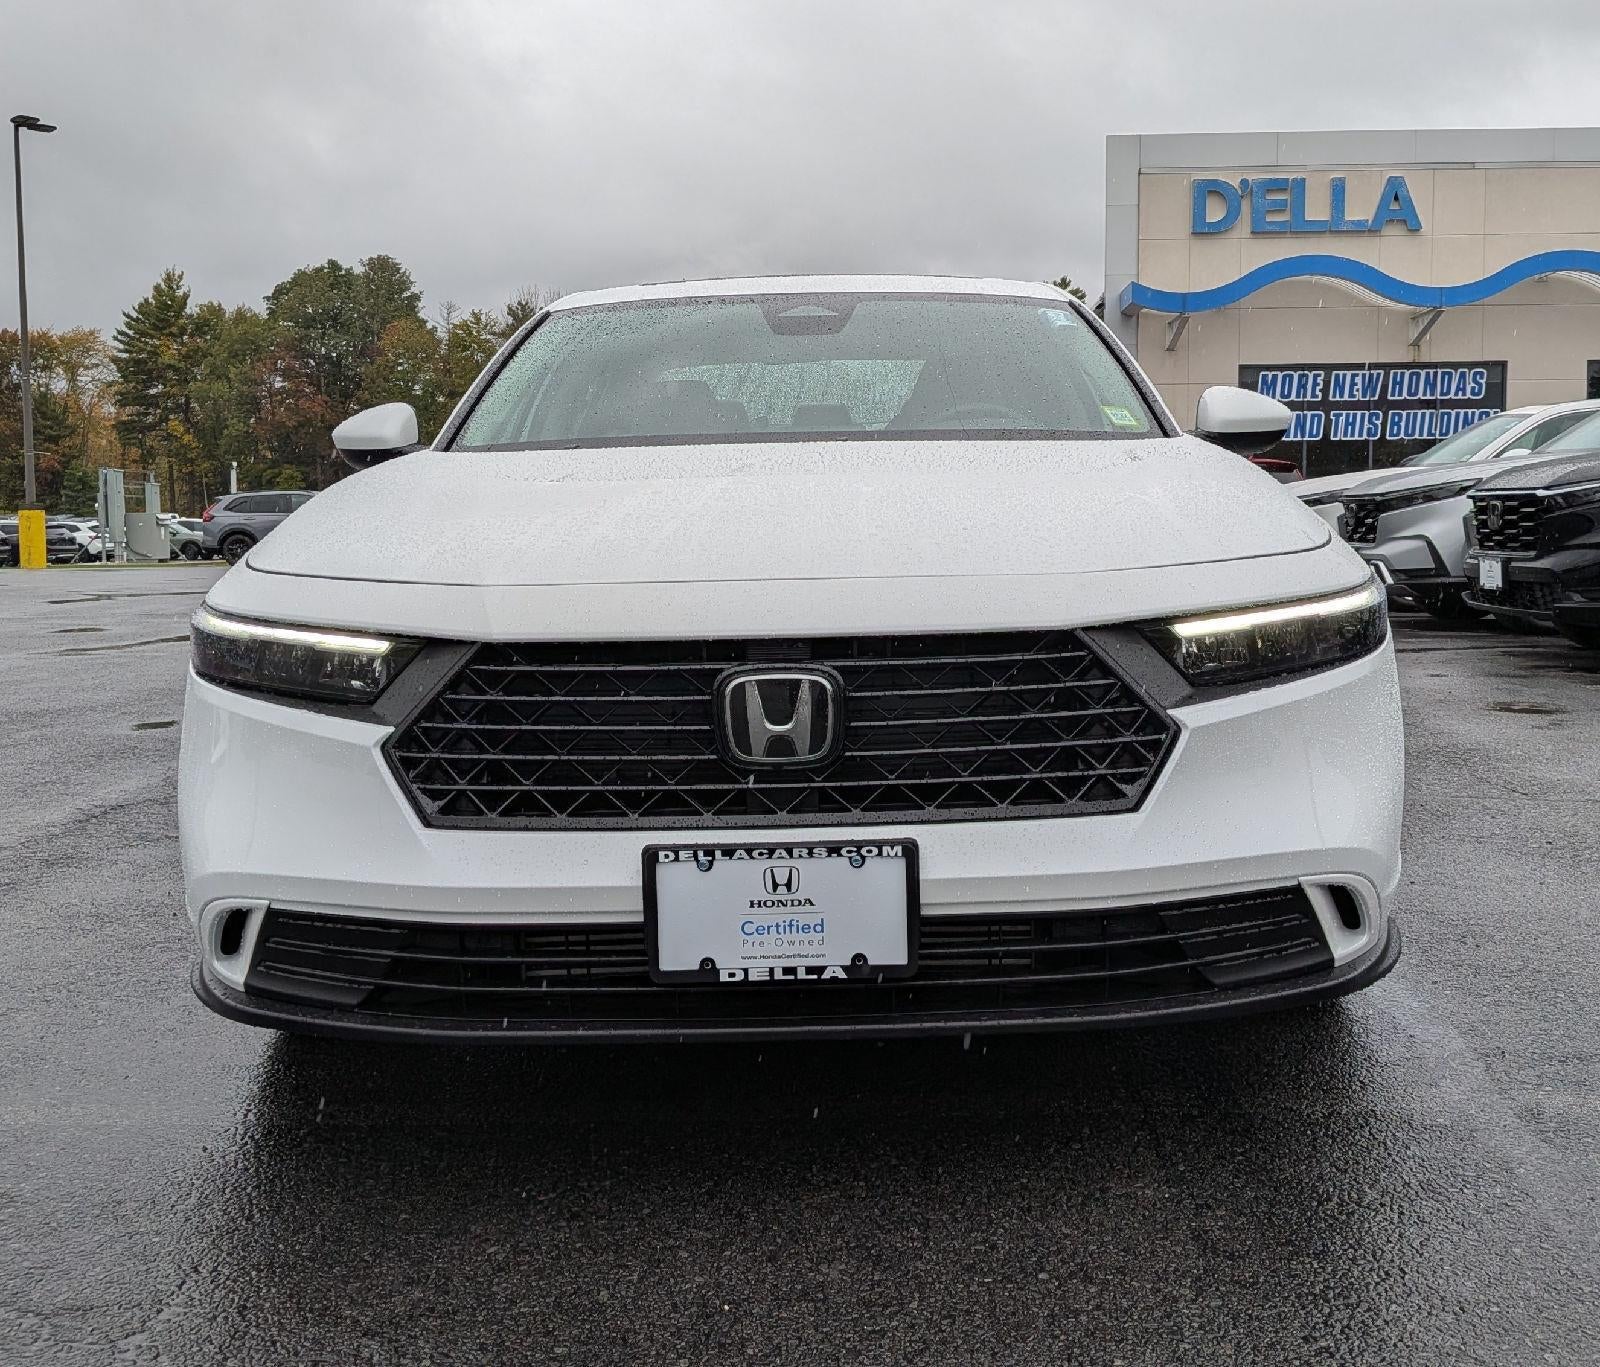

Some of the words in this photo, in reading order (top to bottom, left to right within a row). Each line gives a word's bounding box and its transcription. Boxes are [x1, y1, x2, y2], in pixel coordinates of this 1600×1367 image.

[1191, 176, 1422, 234] D'ELLA
[1258, 371, 1324, 400] MORE
[1329, 371, 1384, 400] NEW
[1389, 369, 1487, 399] HONDAS
[1330, 411, 1382, 440] THIS
[658, 845, 903, 863] DELLACARS.COM
[748, 898, 816, 909] HONDA
[740, 918, 825, 936] Certified
[742, 936, 825, 948] Pre-Owned
[719, 965, 848, 982] DELLA
